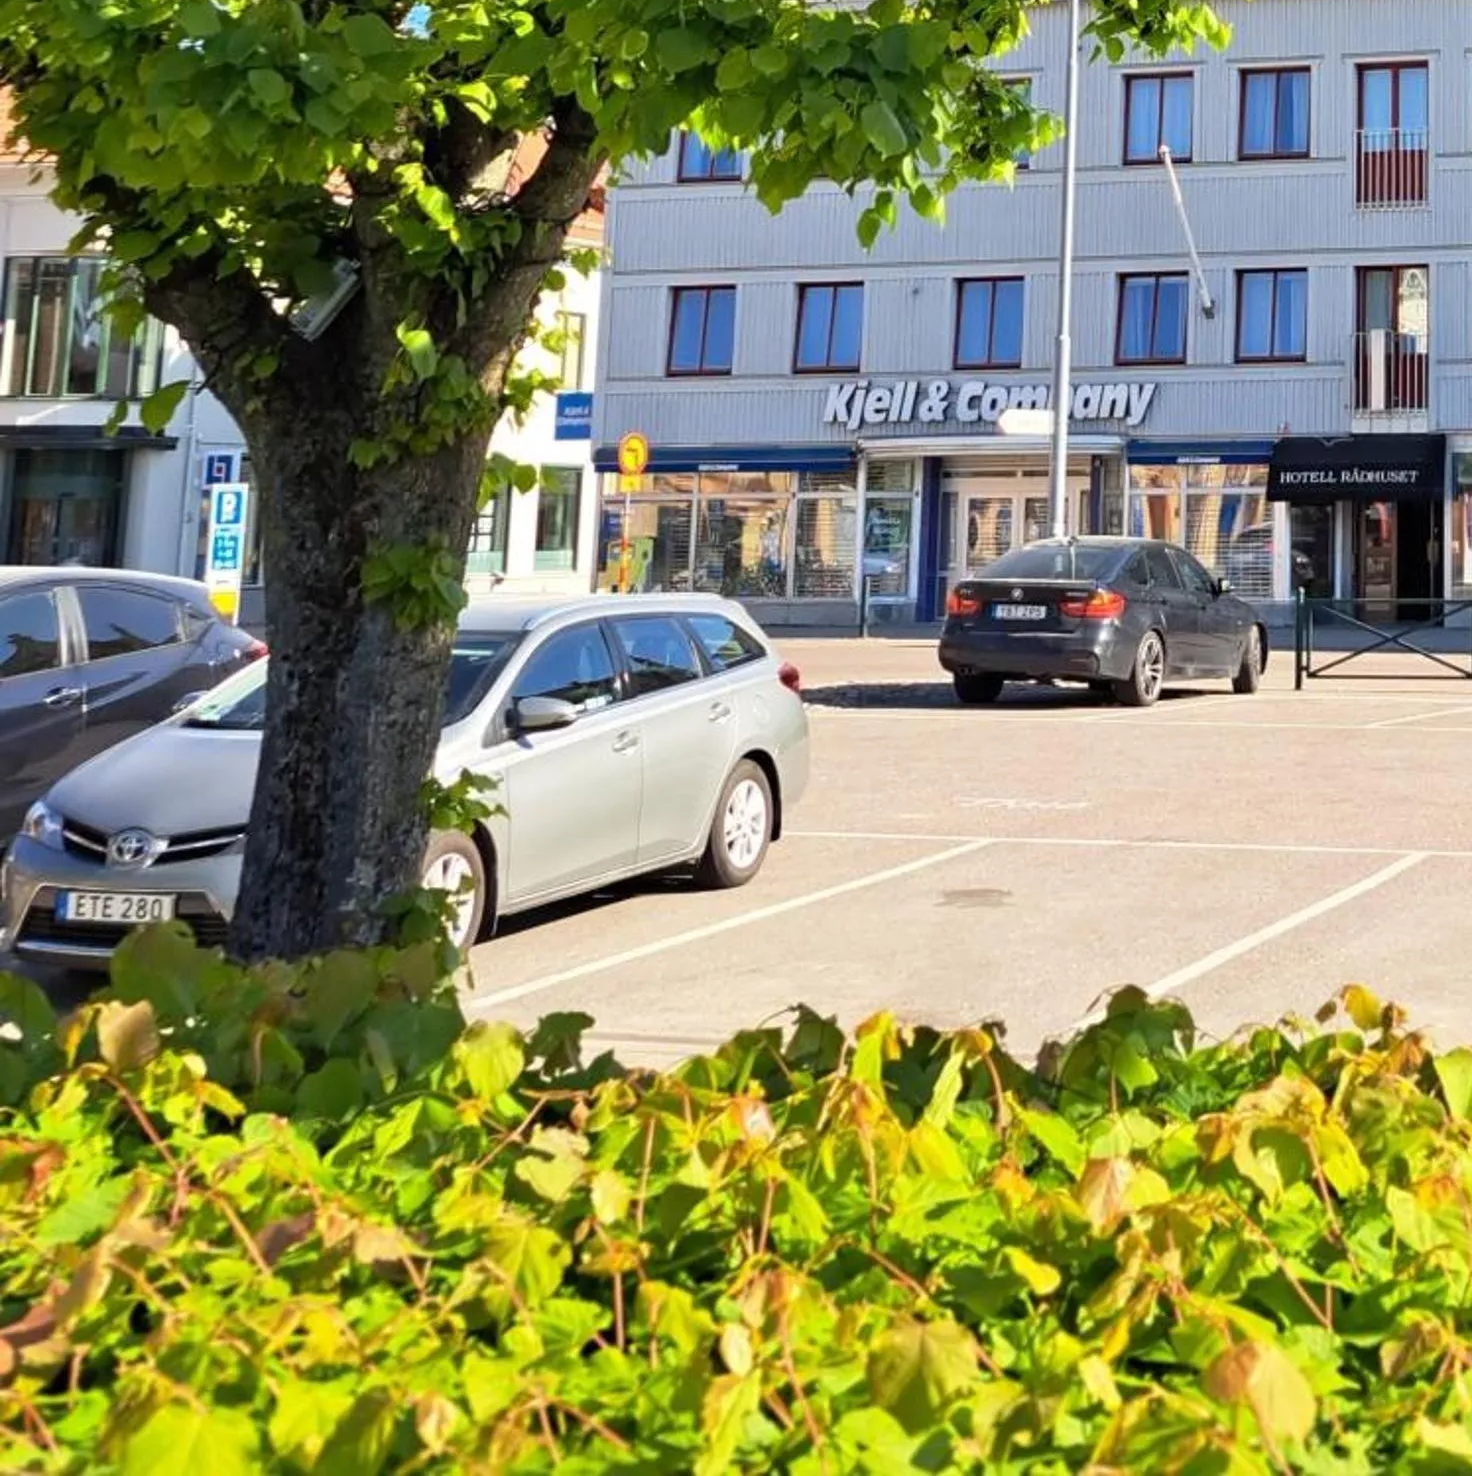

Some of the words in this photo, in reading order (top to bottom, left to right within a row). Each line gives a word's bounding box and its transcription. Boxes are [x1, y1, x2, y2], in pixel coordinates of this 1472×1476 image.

[823, 380, 919, 429] Kjell
[919, 381, 950, 422] &
[955, 381, 1156, 425] Comany
[1280, 471, 1336, 484] HOTELL
[1341, 468, 1418, 483] RÅDHUSET
[75, 895, 114, 918] ETE
[121, 897, 162, 920] 280
